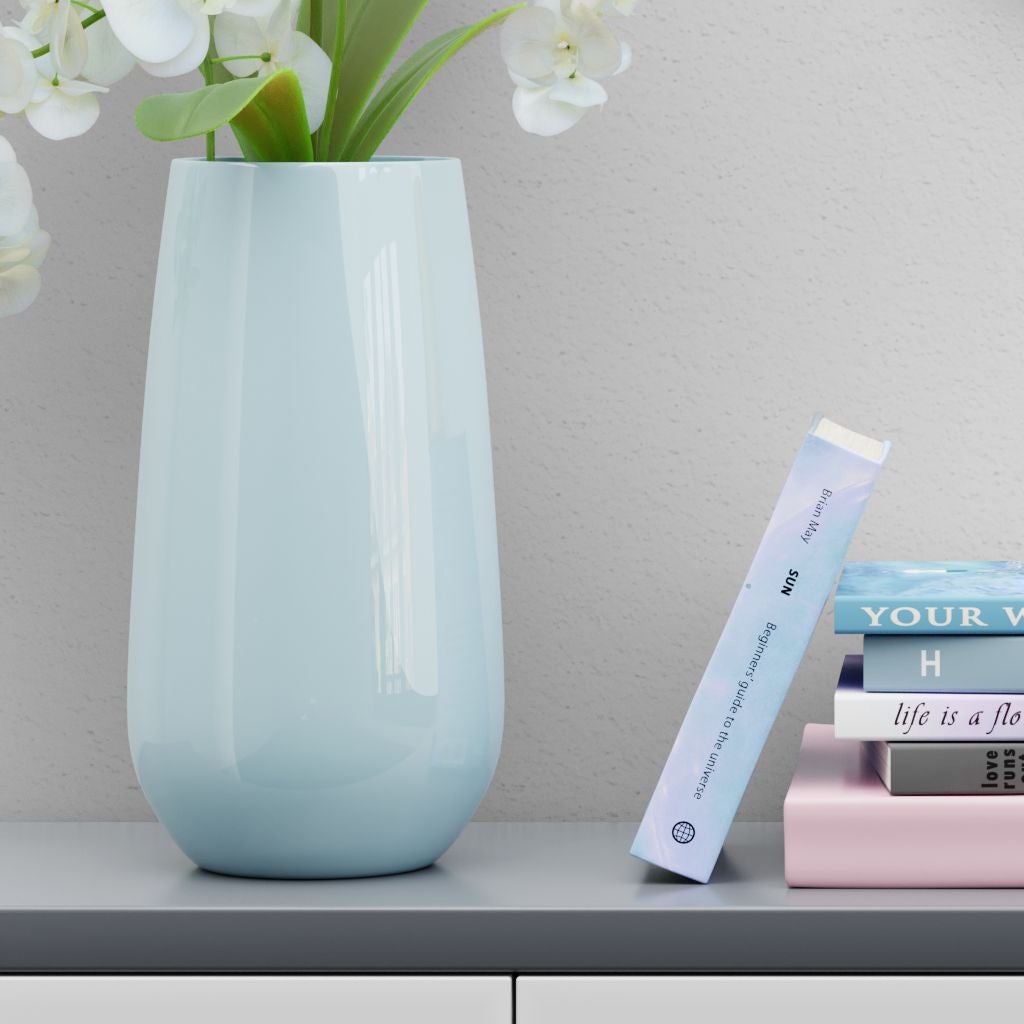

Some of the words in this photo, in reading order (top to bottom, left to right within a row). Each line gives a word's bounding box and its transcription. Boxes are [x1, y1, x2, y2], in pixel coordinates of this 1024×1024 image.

[813, 488, 833, 518] Brian
[800, 520, 819, 544] May
[781, 568, 799, 596] SUN
[860, 606, 988, 627] YOUR
[728, 680, 750, 714] guide
[723, 715, 735, 729] to
[894, 702, 931, 735] life
[940, 705, 957, 727] is
[968, 710, 984, 726] a
[714, 730, 730, 750] the
[693, 751, 723, 800] universe
[981, 750, 998, 788] love
[1003, 749, 1016, 789] runs
